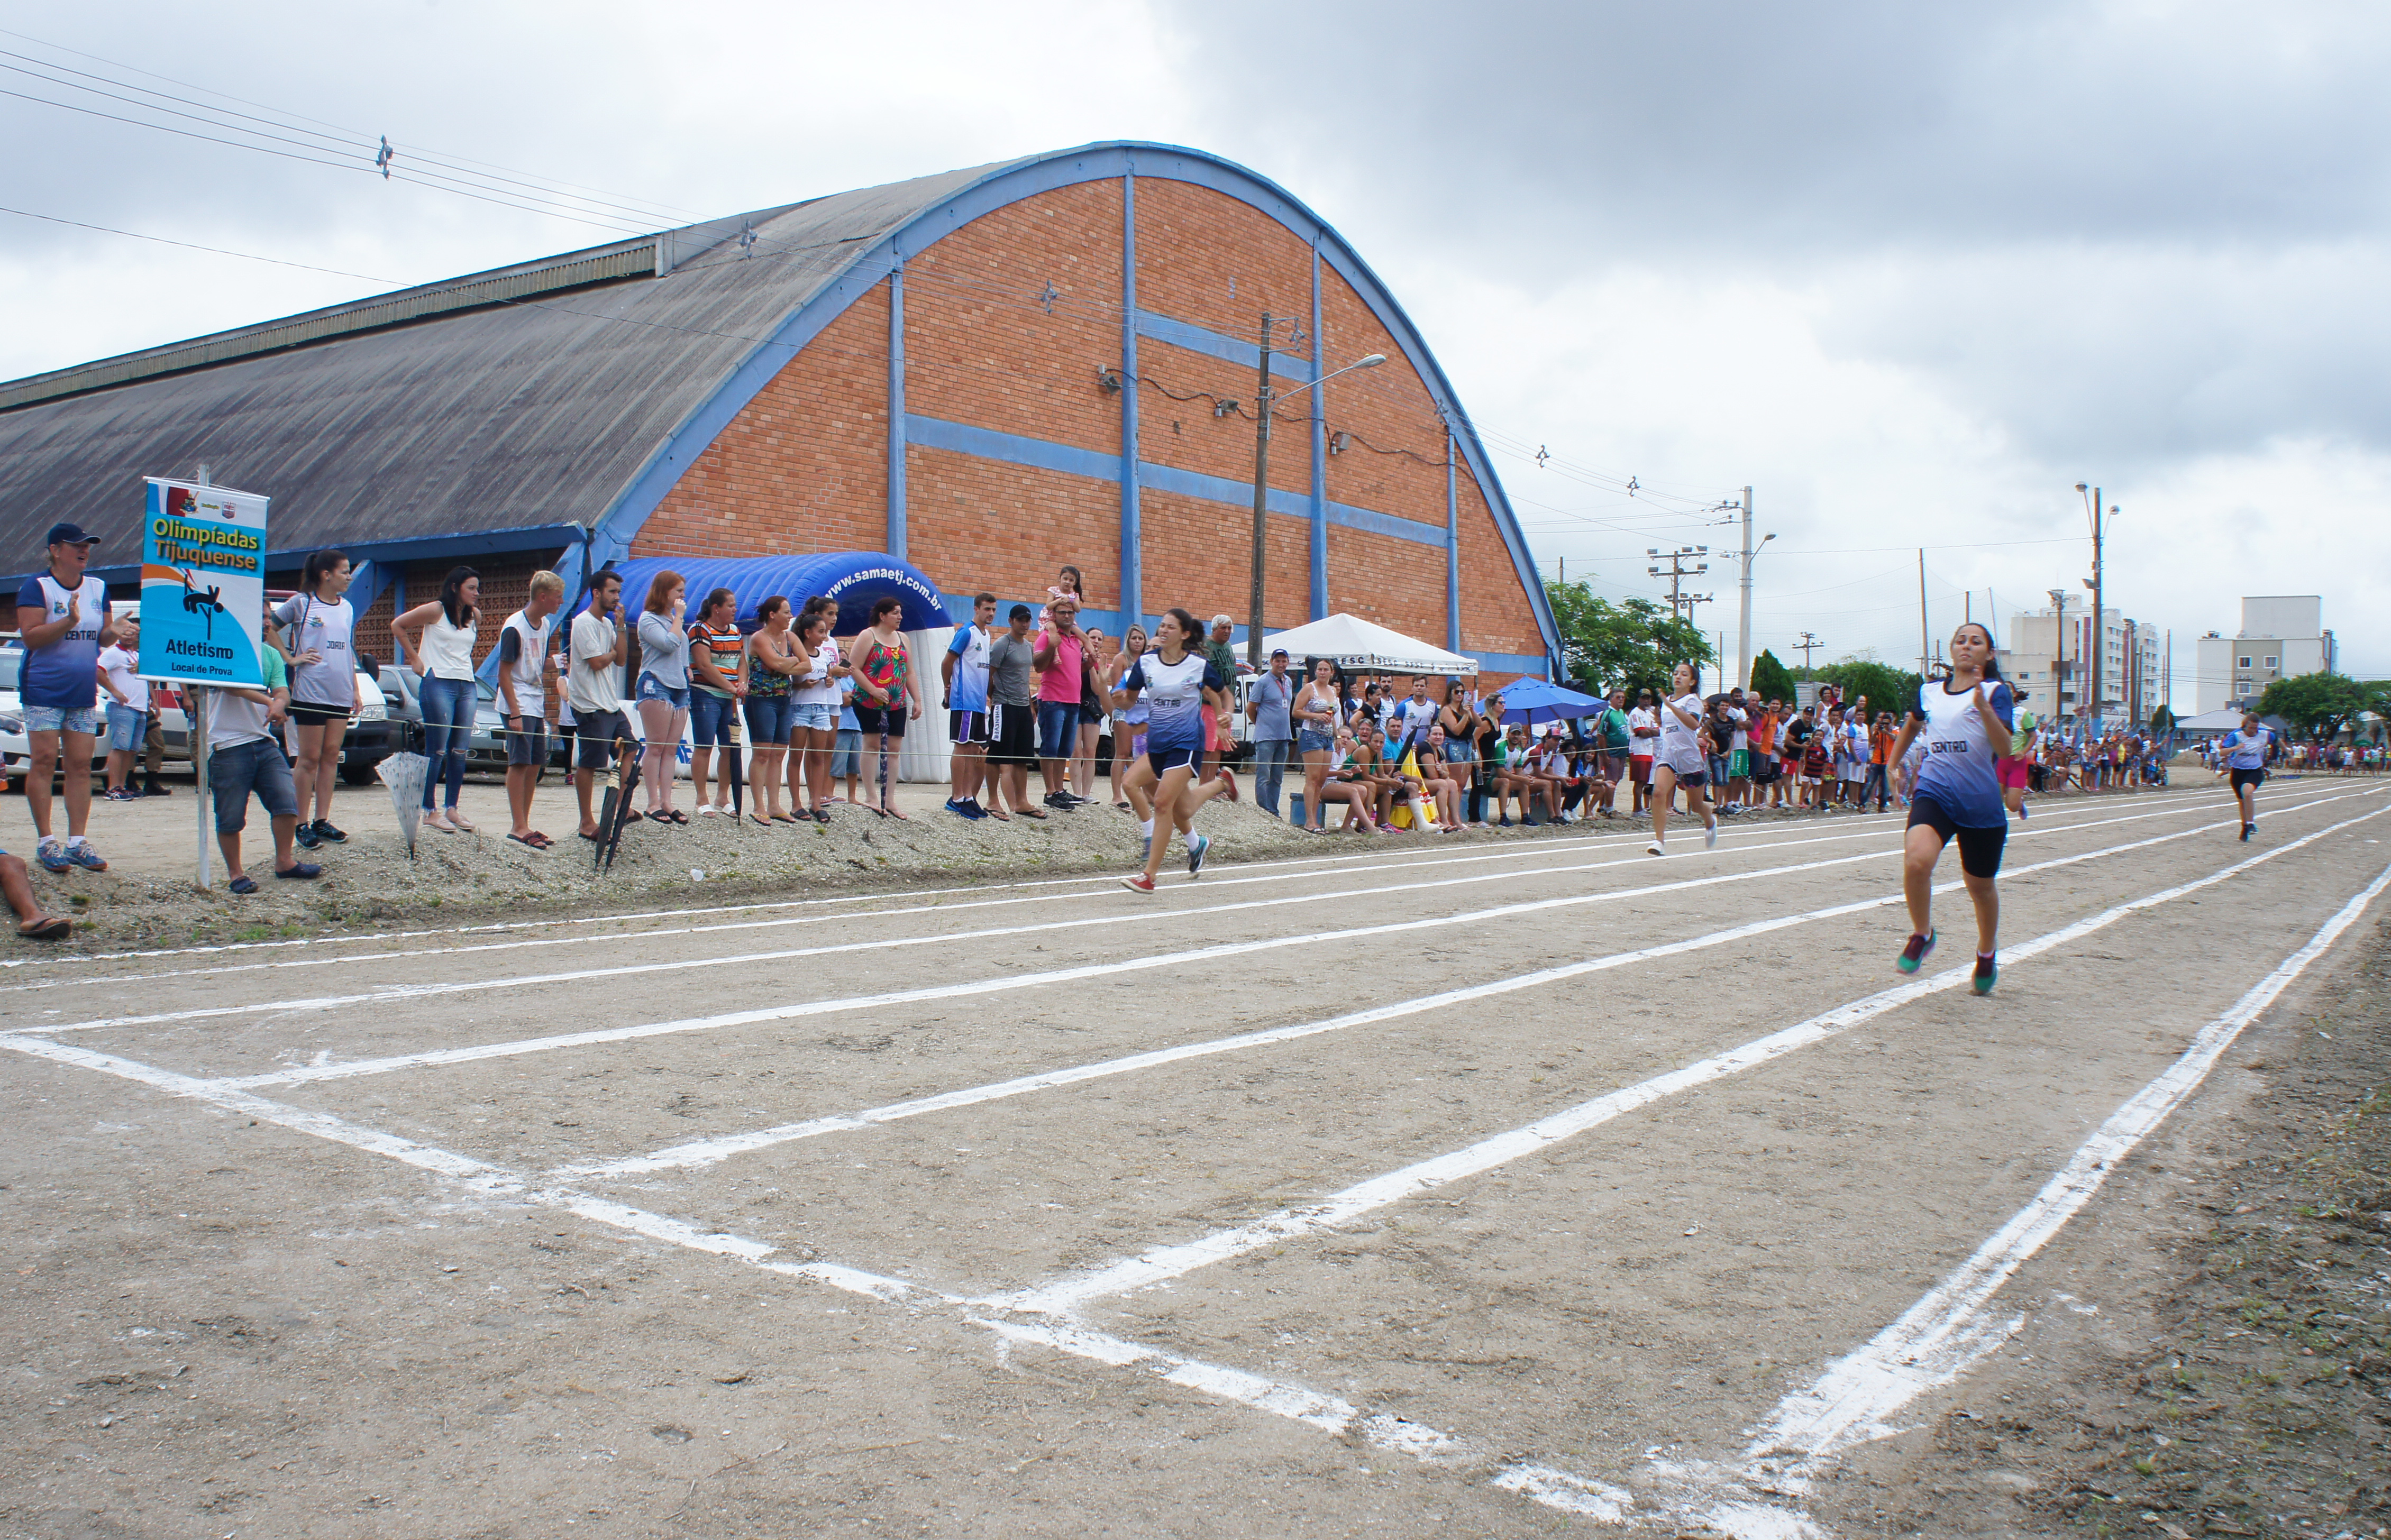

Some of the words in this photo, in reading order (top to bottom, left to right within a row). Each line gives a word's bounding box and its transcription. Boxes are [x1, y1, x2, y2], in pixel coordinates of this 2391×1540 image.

[153, 519, 258, 549] Olimpíadas
[154, 539, 255, 569] Tijuquense
[66, 630, 97, 640] CENTRO
[166, 639, 233, 659] Atletismo
[172, 662, 194, 672] Local
[197, 665, 207, 673] de
[209, 666, 232, 675] Prova
[1931, 741, 1967, 753] CENTRO
